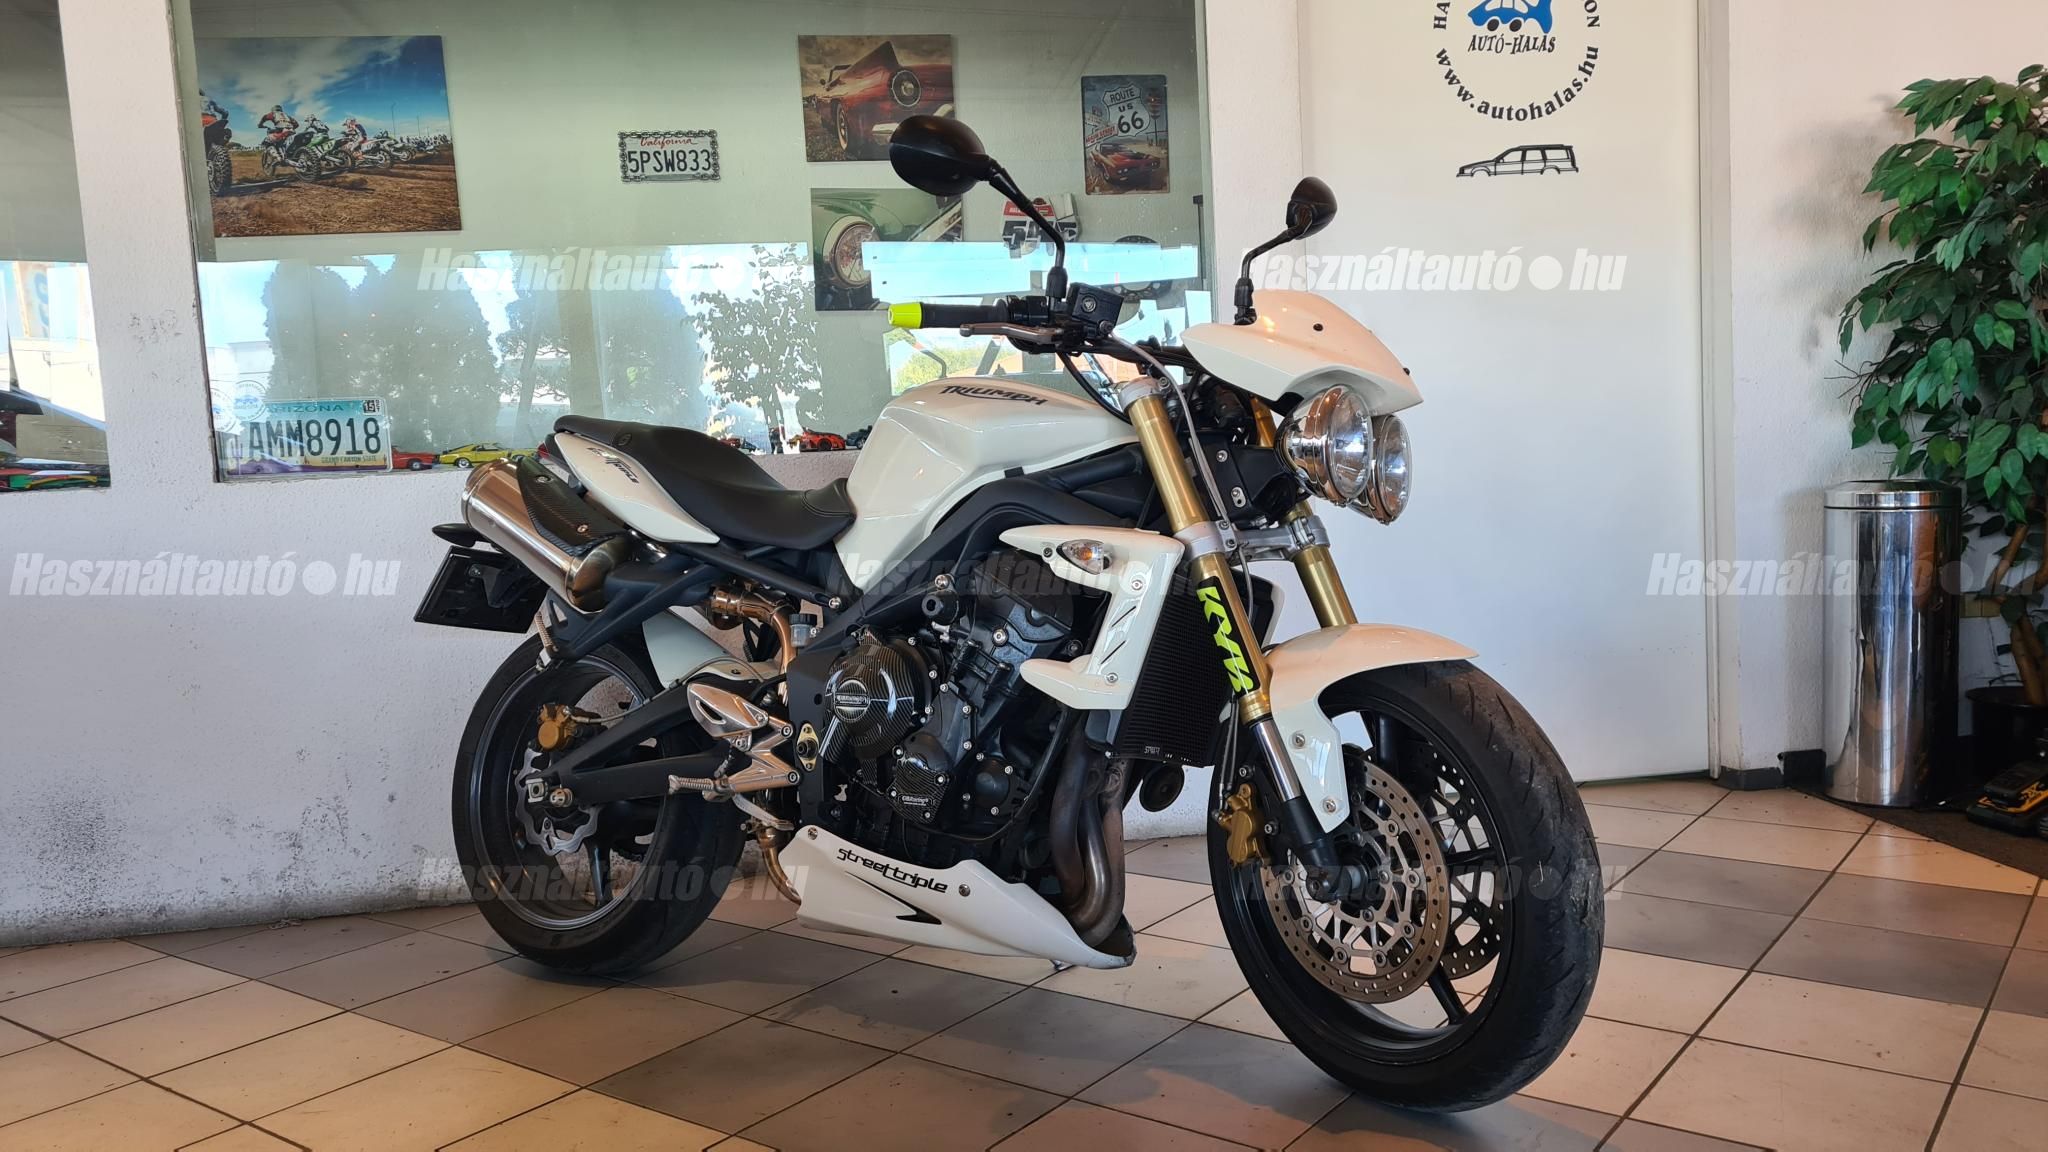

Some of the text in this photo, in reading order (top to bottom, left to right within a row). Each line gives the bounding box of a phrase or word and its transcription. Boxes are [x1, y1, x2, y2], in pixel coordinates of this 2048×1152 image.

[1436, 45, 1599, 122] www.autohalas.hu
[1110, 88, 1135, 103] ROUTE
[1118, 103, 1134, 112] US
[1118, 111, 1144, 133] 66
[640, 137, 698, 149] California
[627, 150, 711, 173] 5PSW833
[939, 385, 1048, 405] TRIUMPH
[266, 403, 344, 414] ARIZONA
[249, 417, 382, 458] AMM8918
[1196, 586, 1254, 692] KYB
